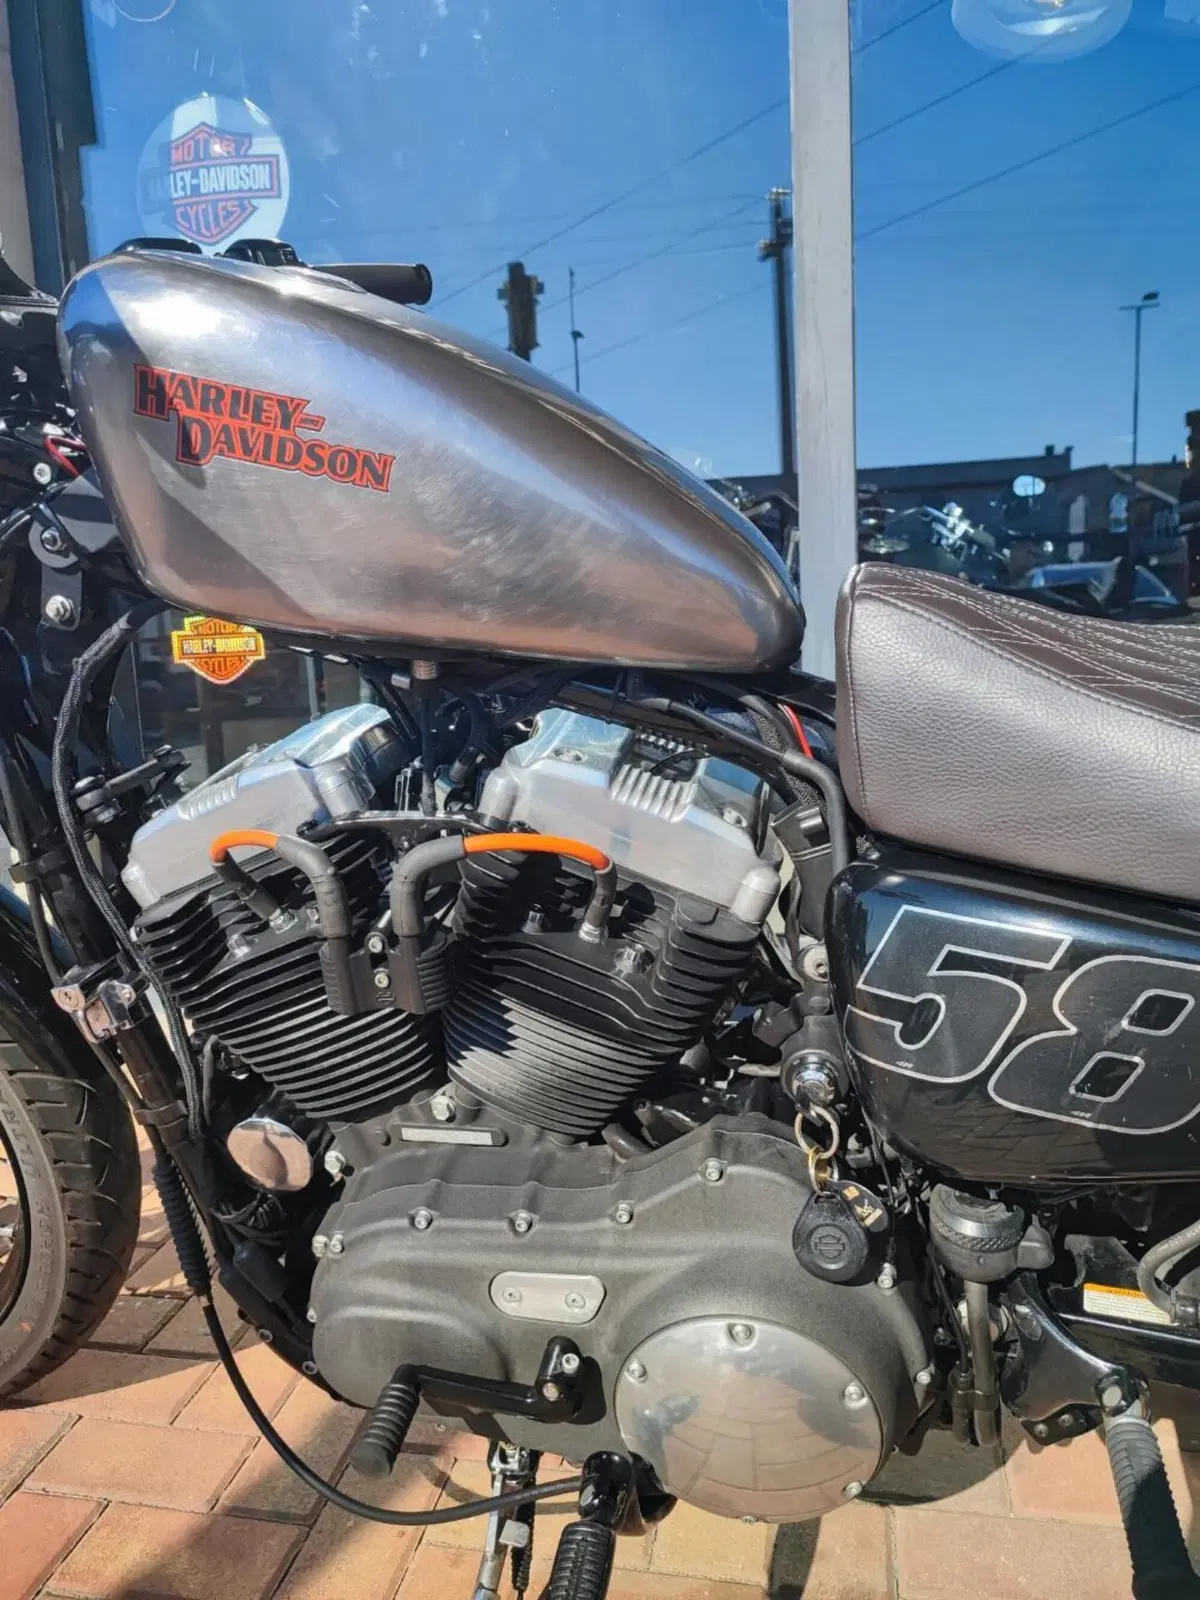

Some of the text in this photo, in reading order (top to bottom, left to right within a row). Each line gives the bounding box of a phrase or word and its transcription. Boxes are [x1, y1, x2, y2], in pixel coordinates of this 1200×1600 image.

[148, 163, 271, 197] LEY-DAVIDSON
[175, 200, 242, 236] CYCLES
[176, 412, 396, 492] DAVIDSON
[844, 904, 1200, 1135] 58
